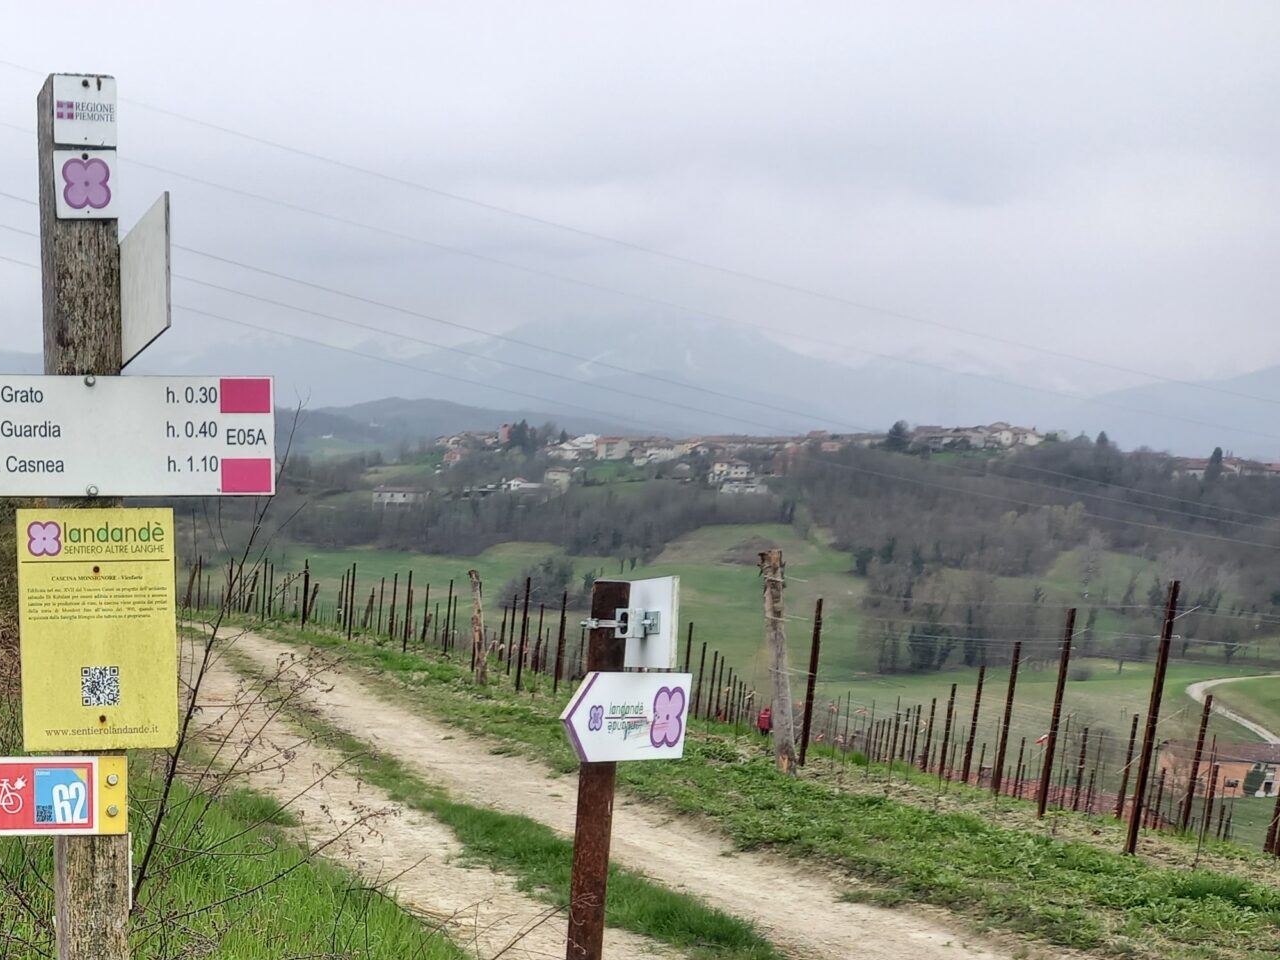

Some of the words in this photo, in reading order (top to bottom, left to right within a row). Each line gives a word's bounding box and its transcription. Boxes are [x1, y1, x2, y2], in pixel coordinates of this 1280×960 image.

[75, 101, 115, 113] REGIONE
[75, 112, 116, 122] PIEMONTE
[0, 384, 44, 404] Grato
[166, 386, 180, 404] h.
[184, 386, 218, 404] 0.30
[0, 420, 62, 438] Guardia
[166, 421, 180, 438] h.
[184, 421, 218, 438] 0.40
[225, 428, 267, 446] E05A
[5, 456, 65, 474] Casnea
[167, 456, 182, 473] h.
[186, 456, 219, 473] 1.10
[64, 521, 164, 543] landandè
[64, 545, 103, 555] SENTIERO
[105, 544, 129, 554] ALTRE
[130, 544, 165, 554] LANGHE
[45, 725, 159, 737] www.sentierolandande.it
[52, 781, 88, 825] 62
